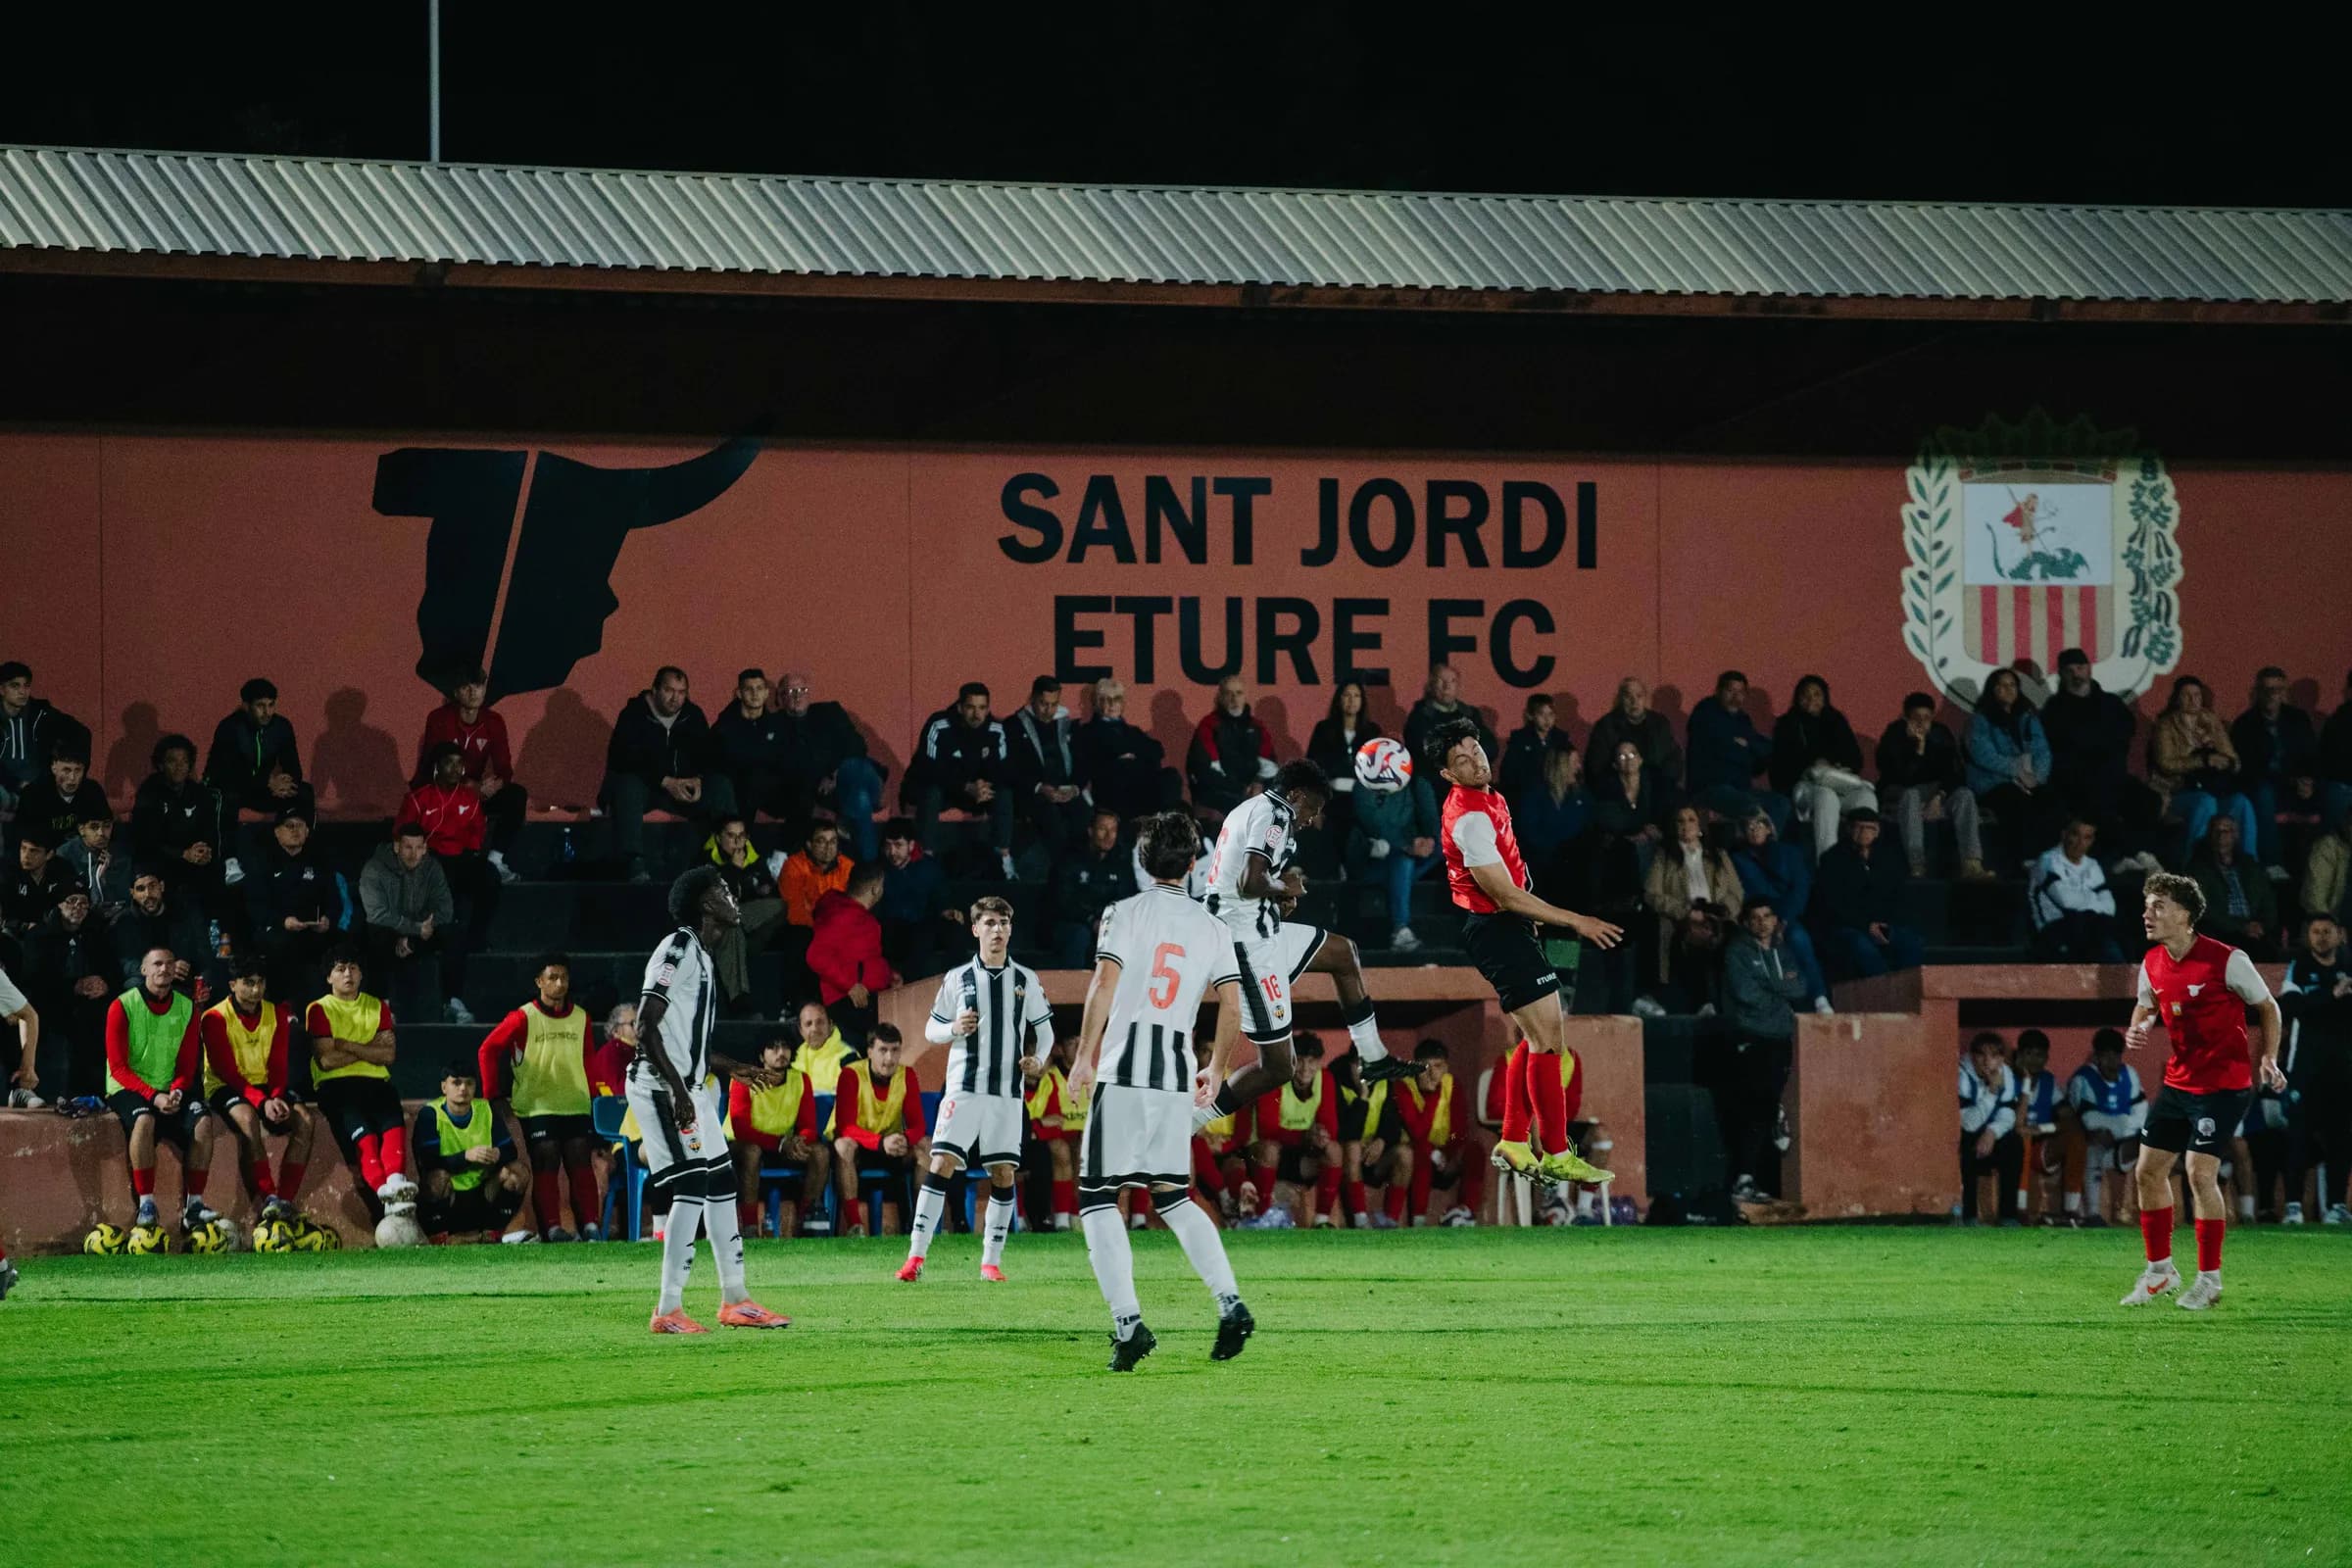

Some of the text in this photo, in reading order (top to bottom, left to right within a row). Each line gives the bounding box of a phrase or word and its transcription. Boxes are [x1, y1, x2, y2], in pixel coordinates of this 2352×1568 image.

[999, 472, 1597, 570] SANT JORDI
[1054, 595, 1556, 688] ETURE FC
[1149, 942, 1186, 1010] 5
[1260, 974, 1283, 1003] 16
